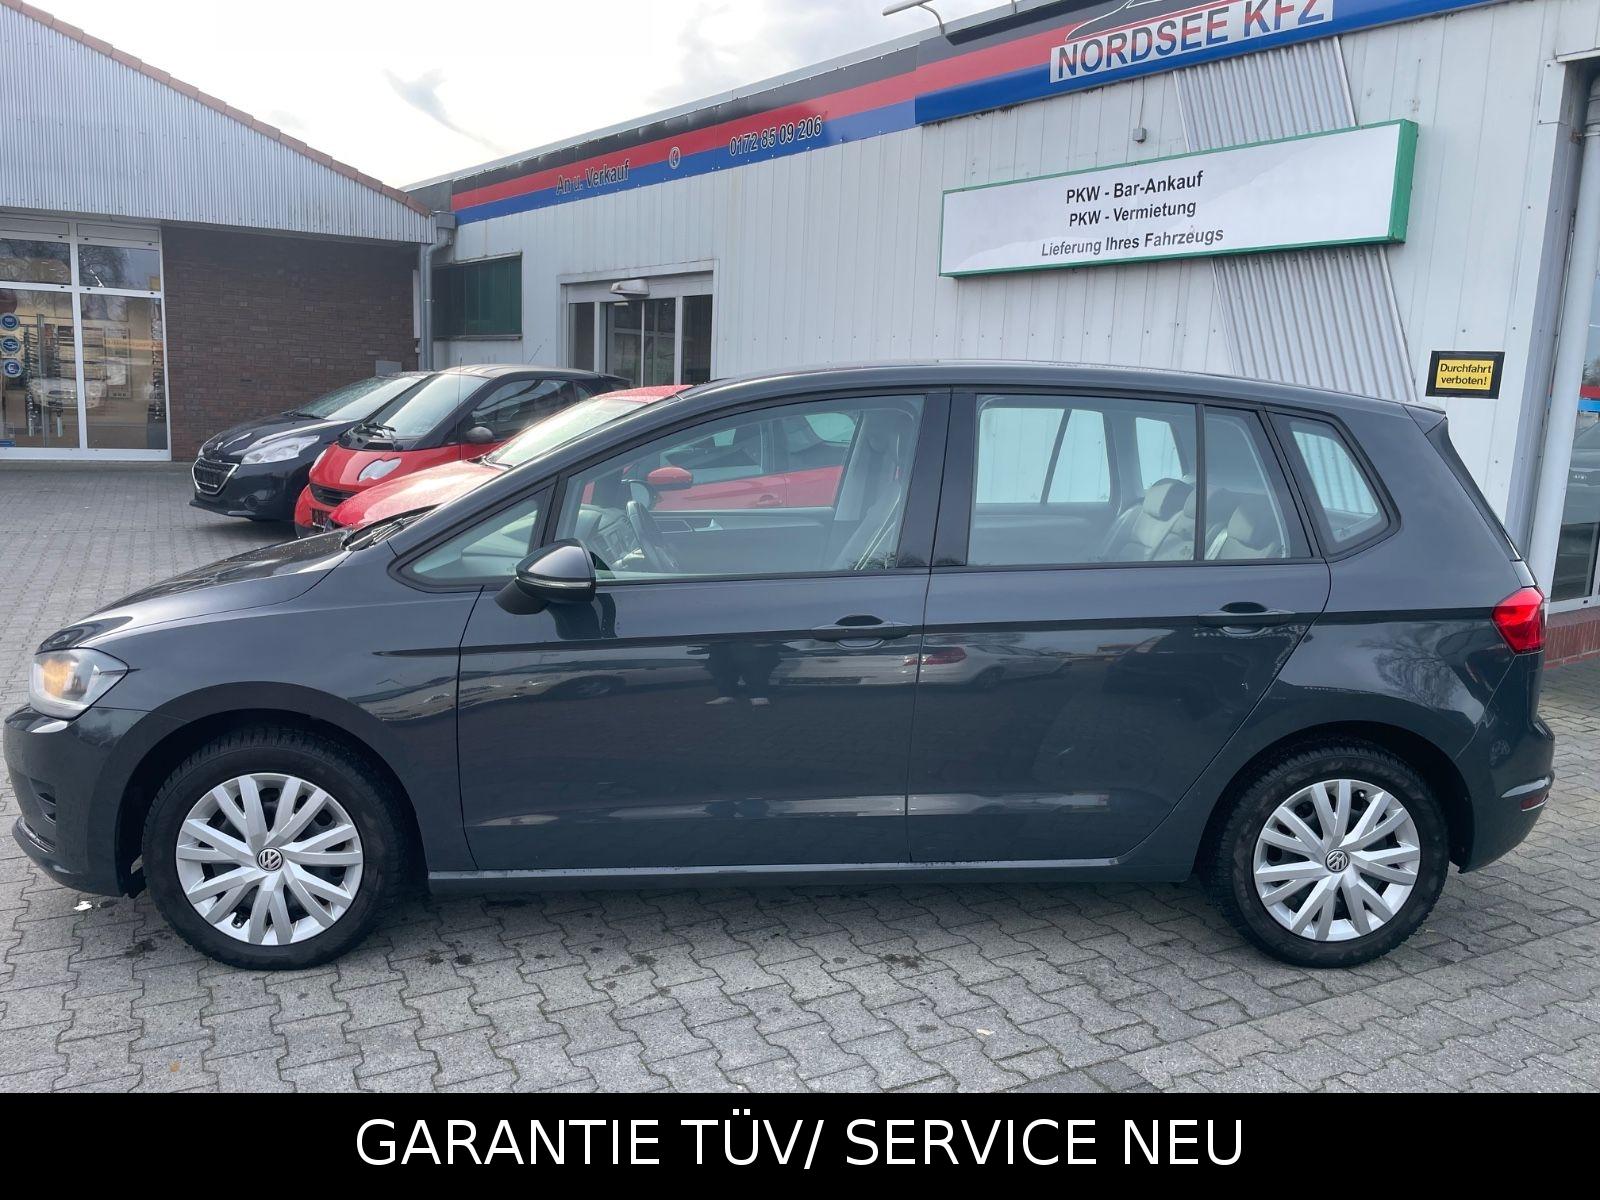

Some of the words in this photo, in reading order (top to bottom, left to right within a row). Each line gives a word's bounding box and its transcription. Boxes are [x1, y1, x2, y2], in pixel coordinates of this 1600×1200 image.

[1058, 6, 1229, 79] NORDSEE
[1244, 0, 1324, 37] KFZ
[729, 135, 758, 157] 0172
[760, 128, 776, 149] 85
[779, 123, 795, 145] 09
[797, 114, 823, 141] 206
[556, 174, 571, 196] An
[571, 176, 583, 192] u.
[585, 160, 630, 189] Verkauf
[1066, 186, 1101, 204] PKW
[1113, 170, 1204, 199] Bar-Ankauf
[1069, 210, 1102, 227] PKW
[1113, 201, 1197, 223] Vermietung
[1041, 241, 1102, 257] Lieferung
[1105, 237, 1140, 251] Ihres
[1144, 228, 1225, 248] Fahrzeugs
[1440, 363, 1492, 374] Durchfahrt
[1441, 375, 1487, 386] verboten!
